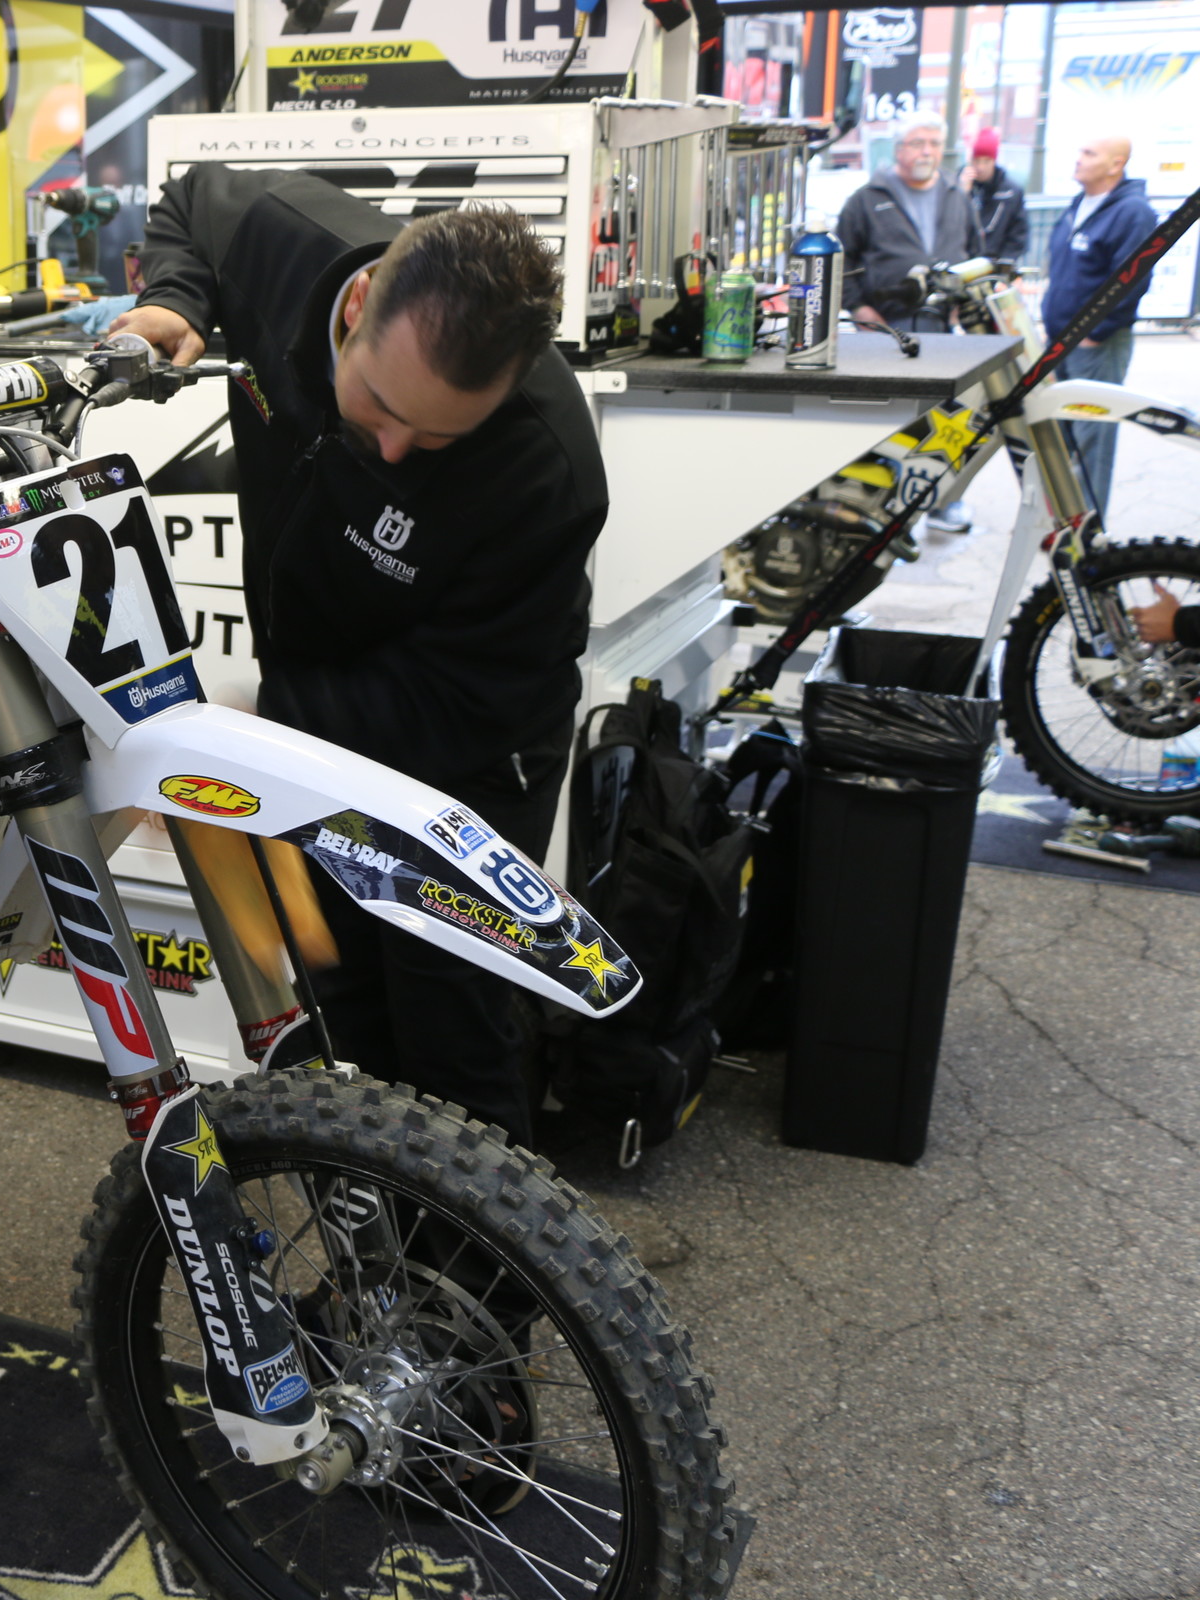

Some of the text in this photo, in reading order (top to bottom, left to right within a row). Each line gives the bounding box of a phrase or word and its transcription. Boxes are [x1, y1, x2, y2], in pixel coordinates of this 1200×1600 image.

[289, 44, 412, 63] ANDERSON
[503, 47, 589, 70] Husqvara
[469, 85, 626, 99] MATRIX ONCEPT
[866, 91, 916, 122] 163
[199, 134, 532, 152] MATRIX CONCEPTS
[809, 256, 824, 316] CONTACT
[40, 470, 104, 501] MOSTER
[344, 524, 418, 578] Husqvarna
[31, 496, 191, 686] 21
[140, 672, 186, 701] Husqvarna
[160, 779, 261, 810] FMF
[425, 897, 520, 951] ENERGY DRINK
[163, 1193, 241, 1378] DUNLOP
[215, 1242, 258, 1350] SCOSCHE
